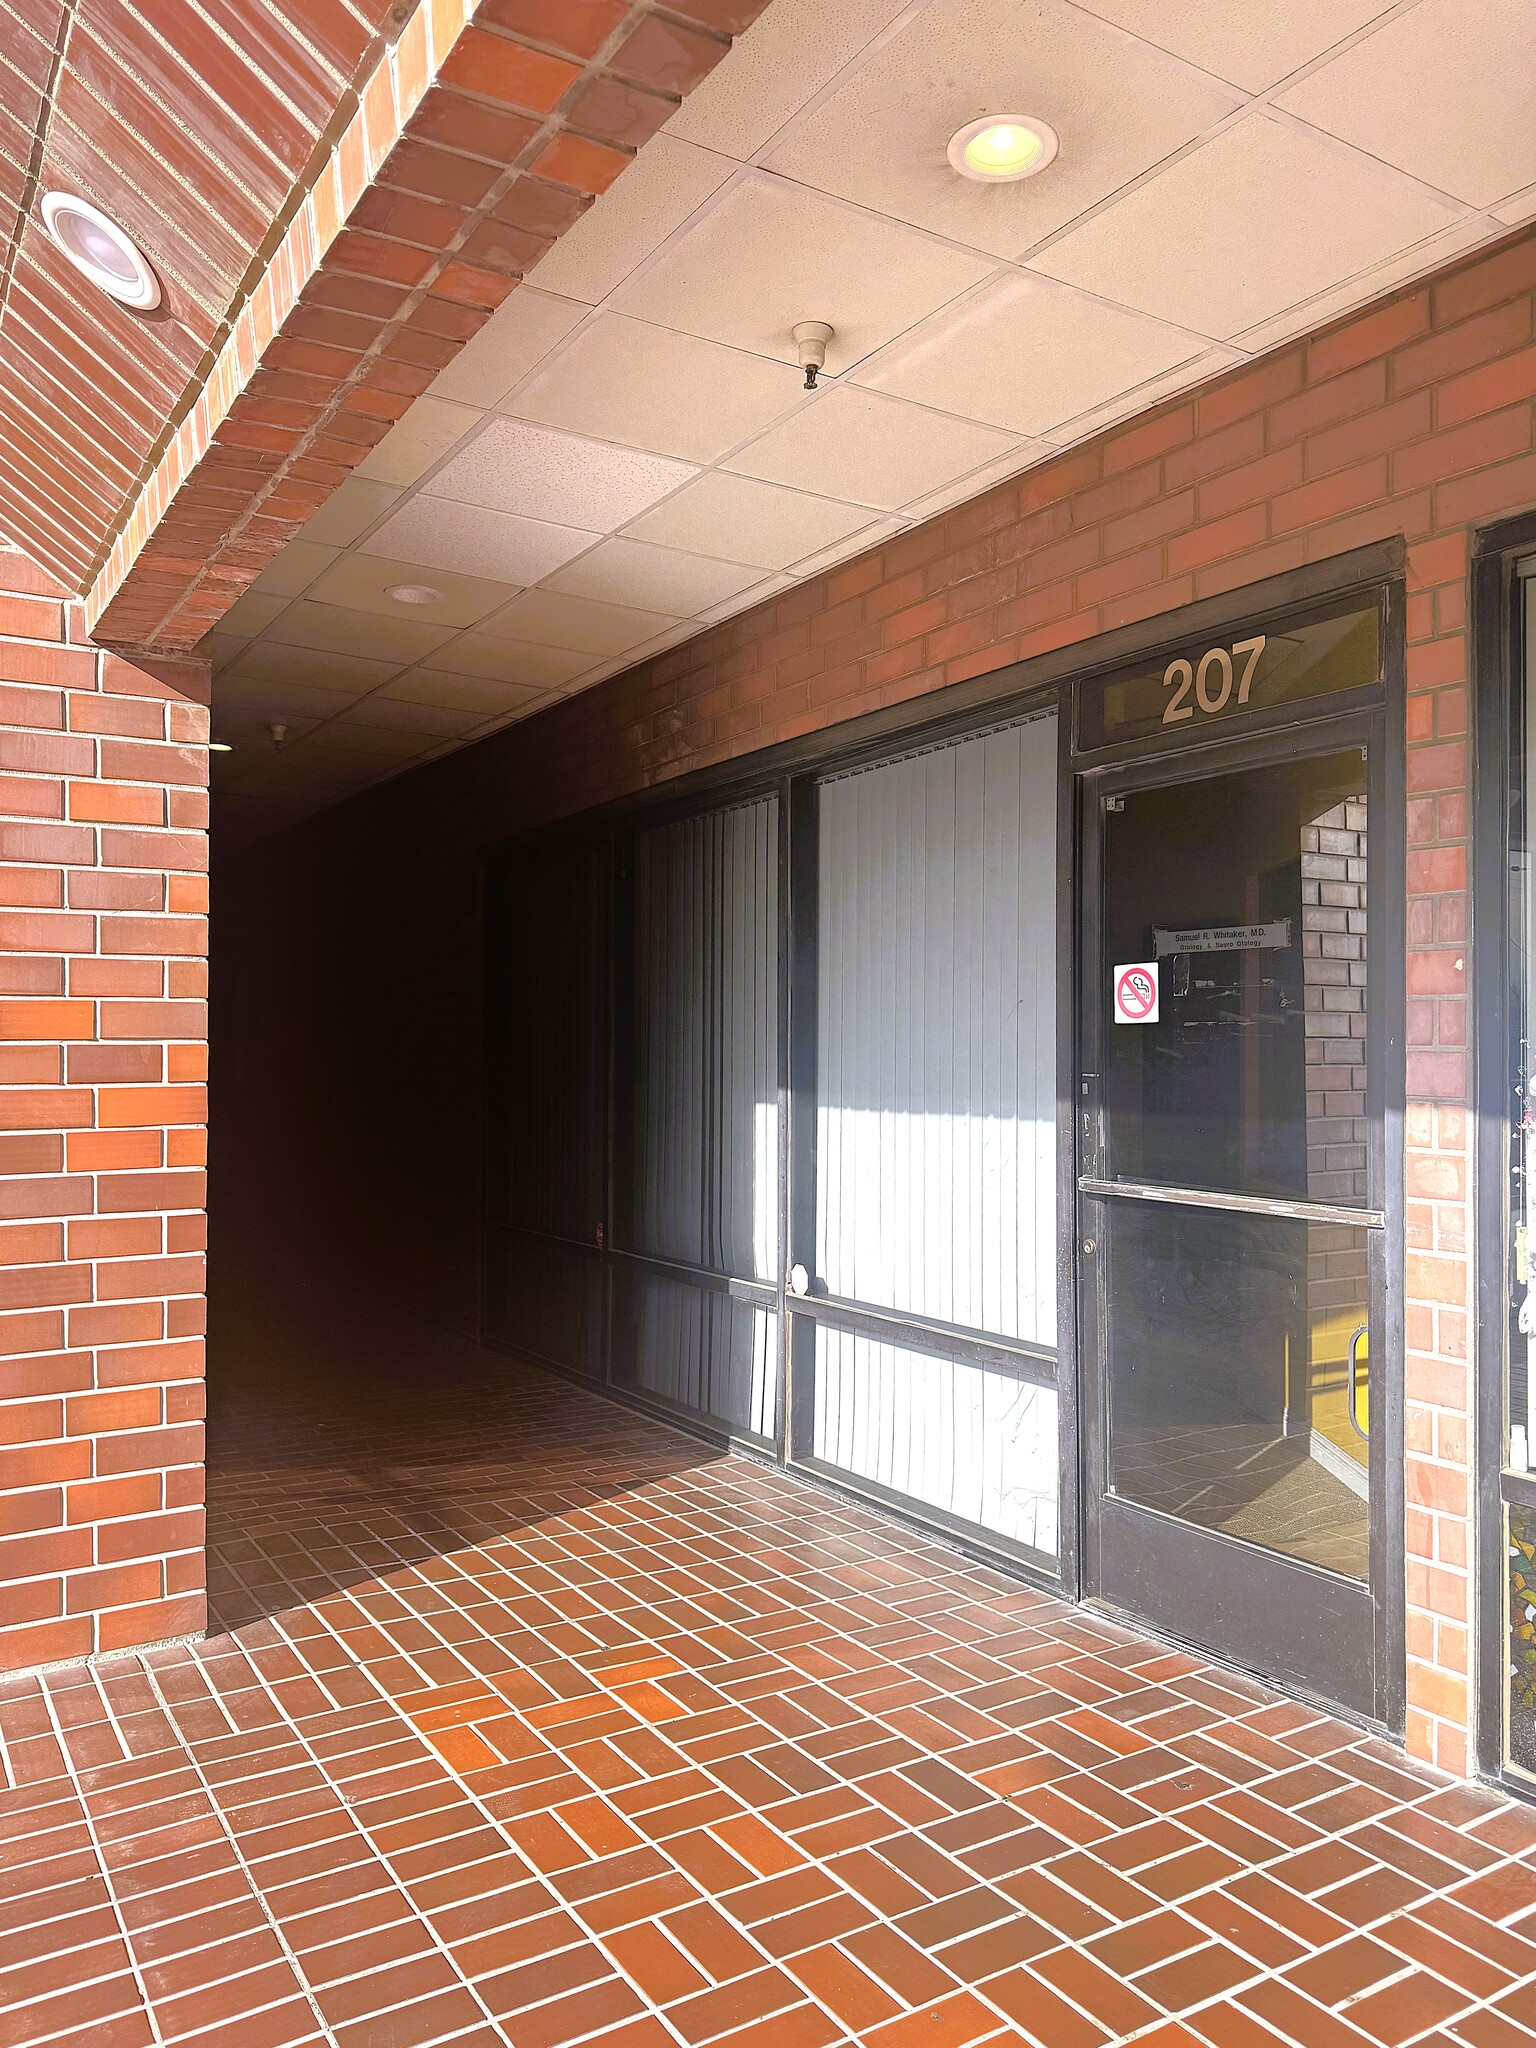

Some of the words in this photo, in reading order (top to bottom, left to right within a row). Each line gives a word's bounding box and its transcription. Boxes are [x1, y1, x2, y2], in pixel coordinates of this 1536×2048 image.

[1162, 635, 1266, 724] 207
[1175, 933, 1200, 942] Samuel
[1213, 930, 1248, 939] Whitaker,
